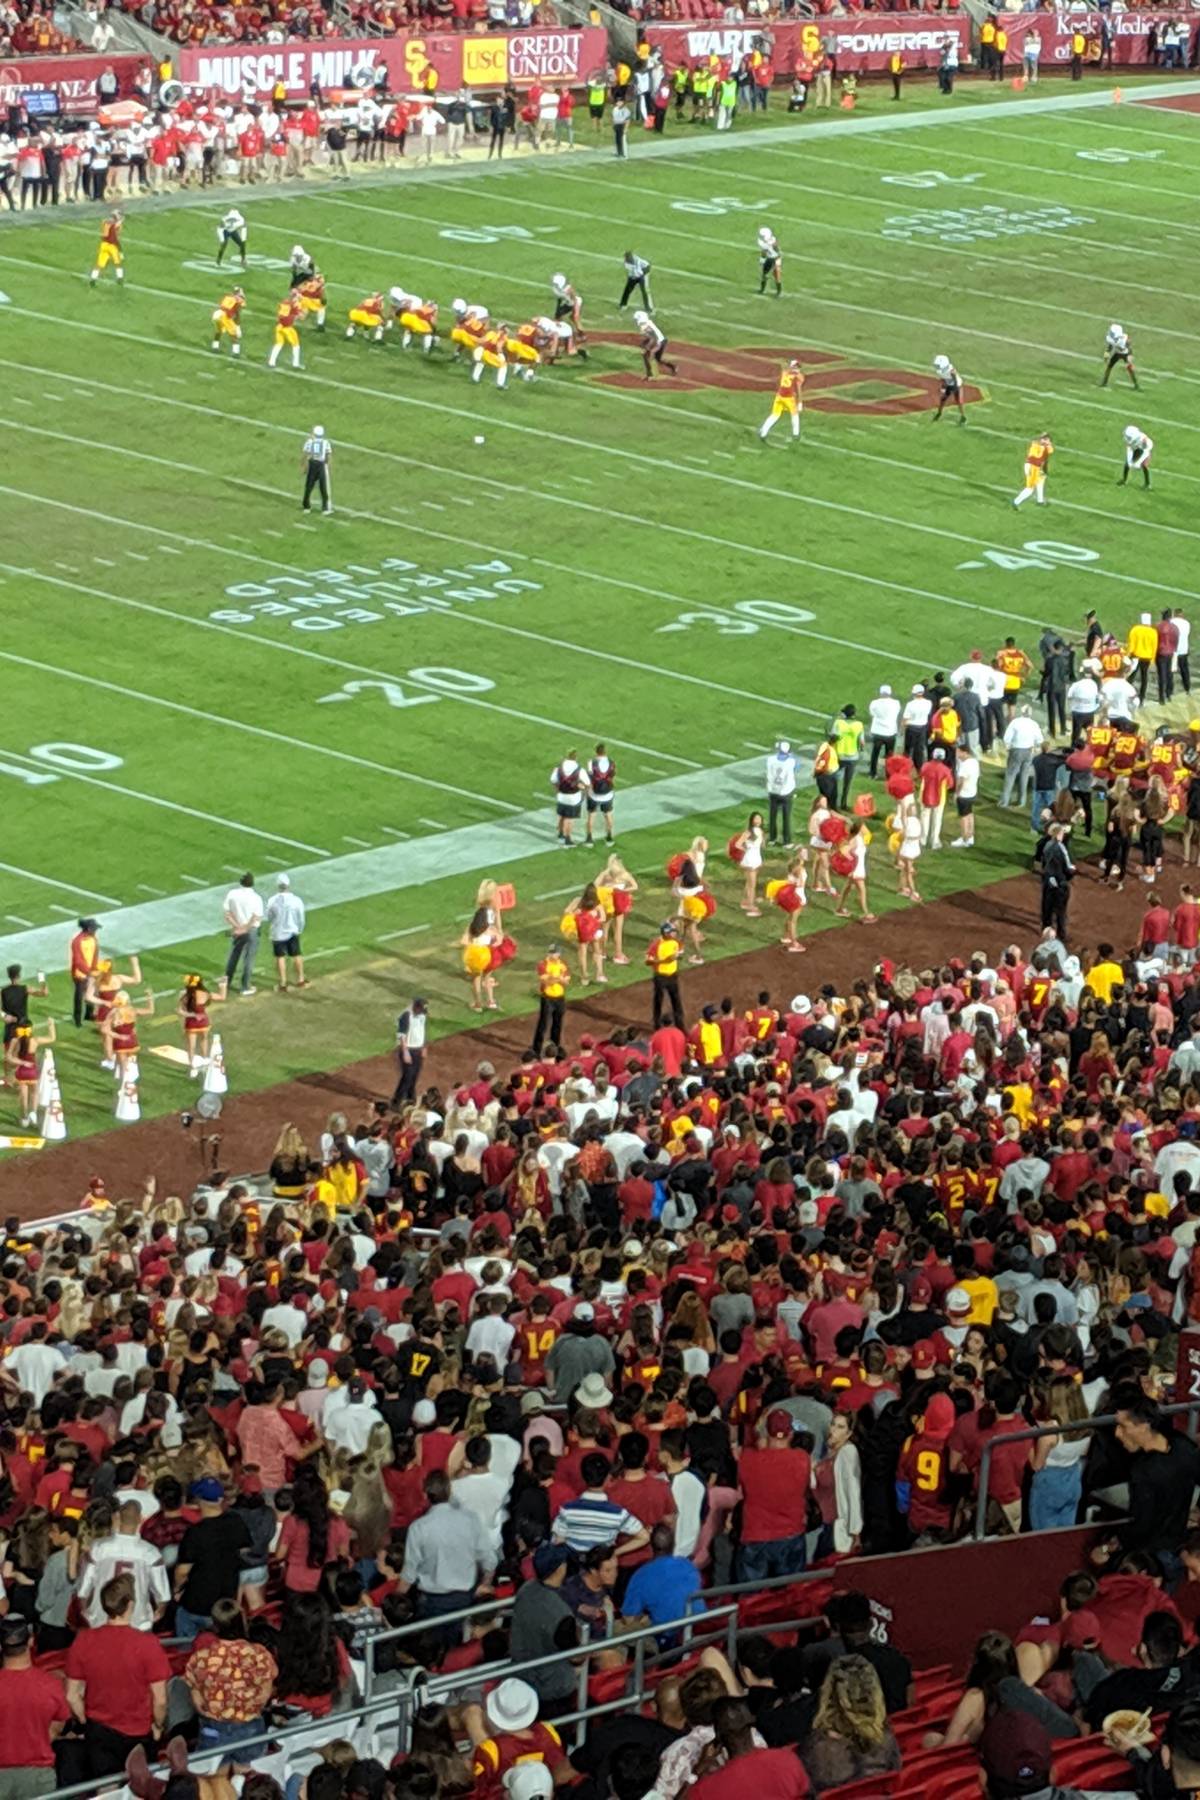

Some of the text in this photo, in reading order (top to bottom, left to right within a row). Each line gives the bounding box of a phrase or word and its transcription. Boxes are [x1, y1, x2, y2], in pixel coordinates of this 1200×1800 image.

[467, 49, 504, 70] USC
[509, 33, 583, 56] CREDIT
[198, 54, 305, 94] MUSCLE
[510, 52, 578, 77] UNION
[982, 540, 1101, 571] 40
[208, 559, 513, 624] AIRLINES
[224, 557, 419, 597] FIELD
[290, 579, 544, 631] UNITED
[677, 600, 817, 635] 30
[342, 666, 496, 708] 20
[1033, 983, 1048, 1005] 7
[758, 1017, 771, 1039] 7
[949, 1183, 965, 1208] 2
[984, 1177, 999, 1205] 7
[526, 1328, 556, 1360] 14
[916, 1450, 941, 1491] 9
[869, 1616, 888, 1643] 26
